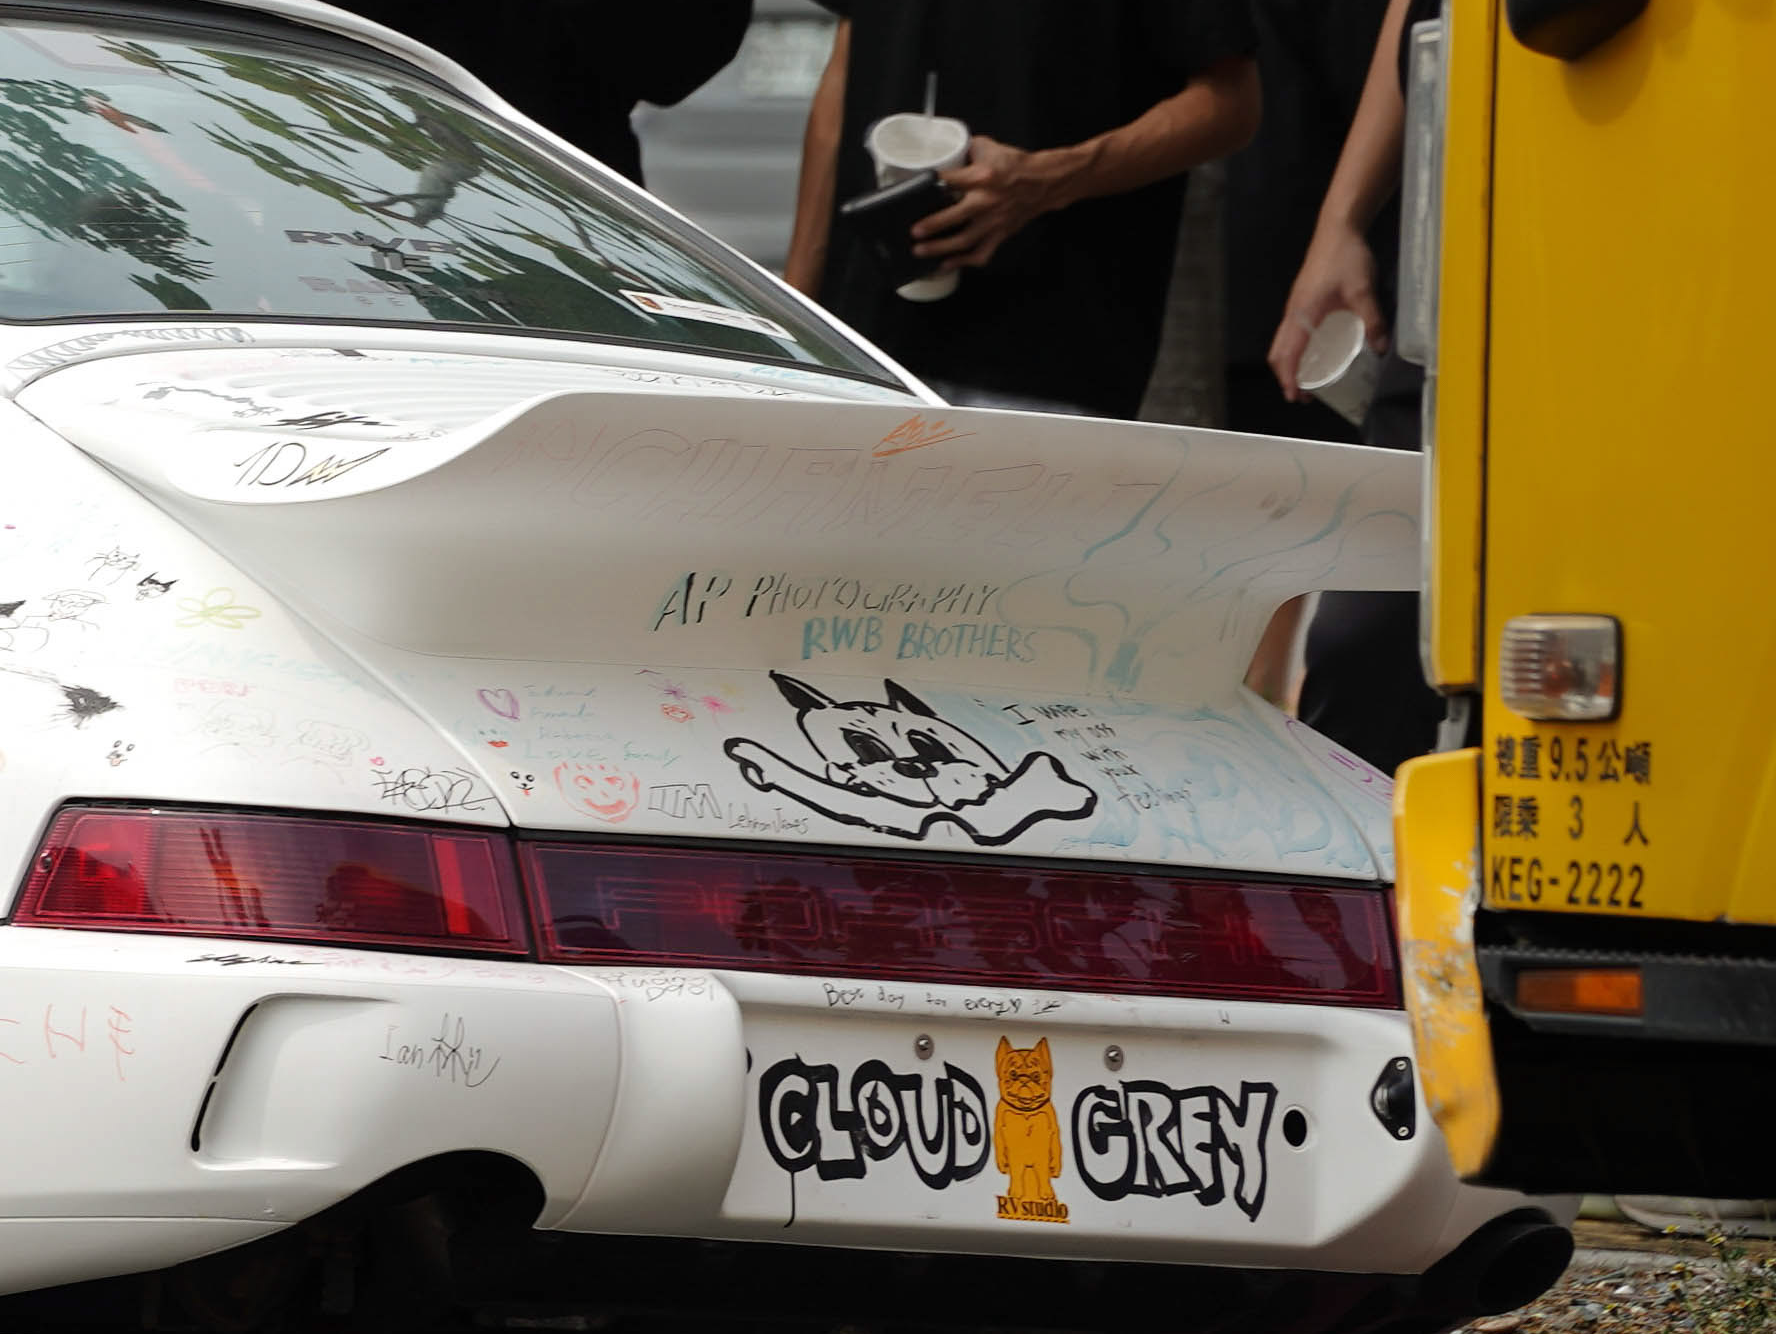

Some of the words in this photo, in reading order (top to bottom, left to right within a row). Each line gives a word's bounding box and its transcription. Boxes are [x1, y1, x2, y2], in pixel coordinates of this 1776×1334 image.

[802, 617, 884, 661] RWB
[895, 618, 1036, 664] BROTHERS
[1002, 703, 1035, 726] I
[1569, 796, 1584, 840] 3
[1624, 802, 1651, 847] 人
[1491, 855, 1645, 909] KEG-2222
